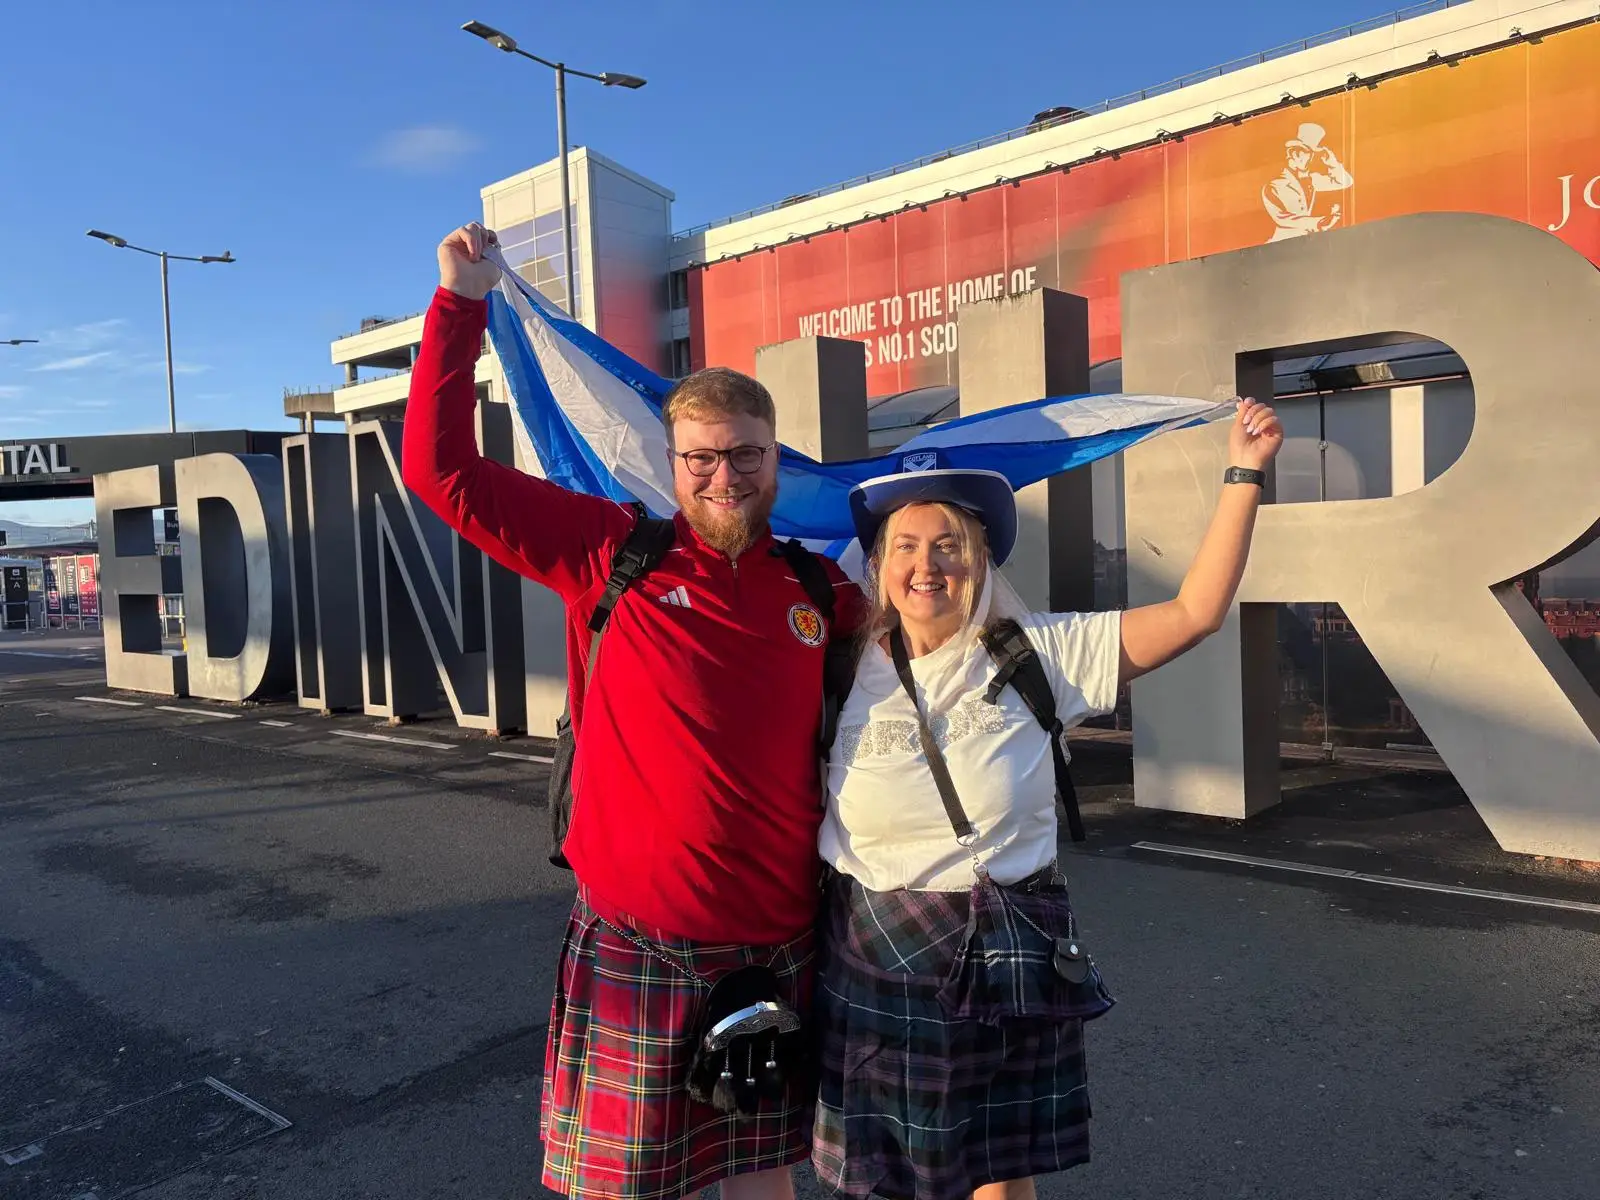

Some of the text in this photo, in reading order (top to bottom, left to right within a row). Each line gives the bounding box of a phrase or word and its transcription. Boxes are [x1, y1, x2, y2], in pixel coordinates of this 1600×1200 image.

[798, 266, 1037, 338] WELCOME TO THE HOME OF
[878, 330, 915, 365] NO.1
[920, 320, 959, 358] SCO
[0, 443, 71, 475] TAL
[904, 453, 935, 463] SCOTLAND
